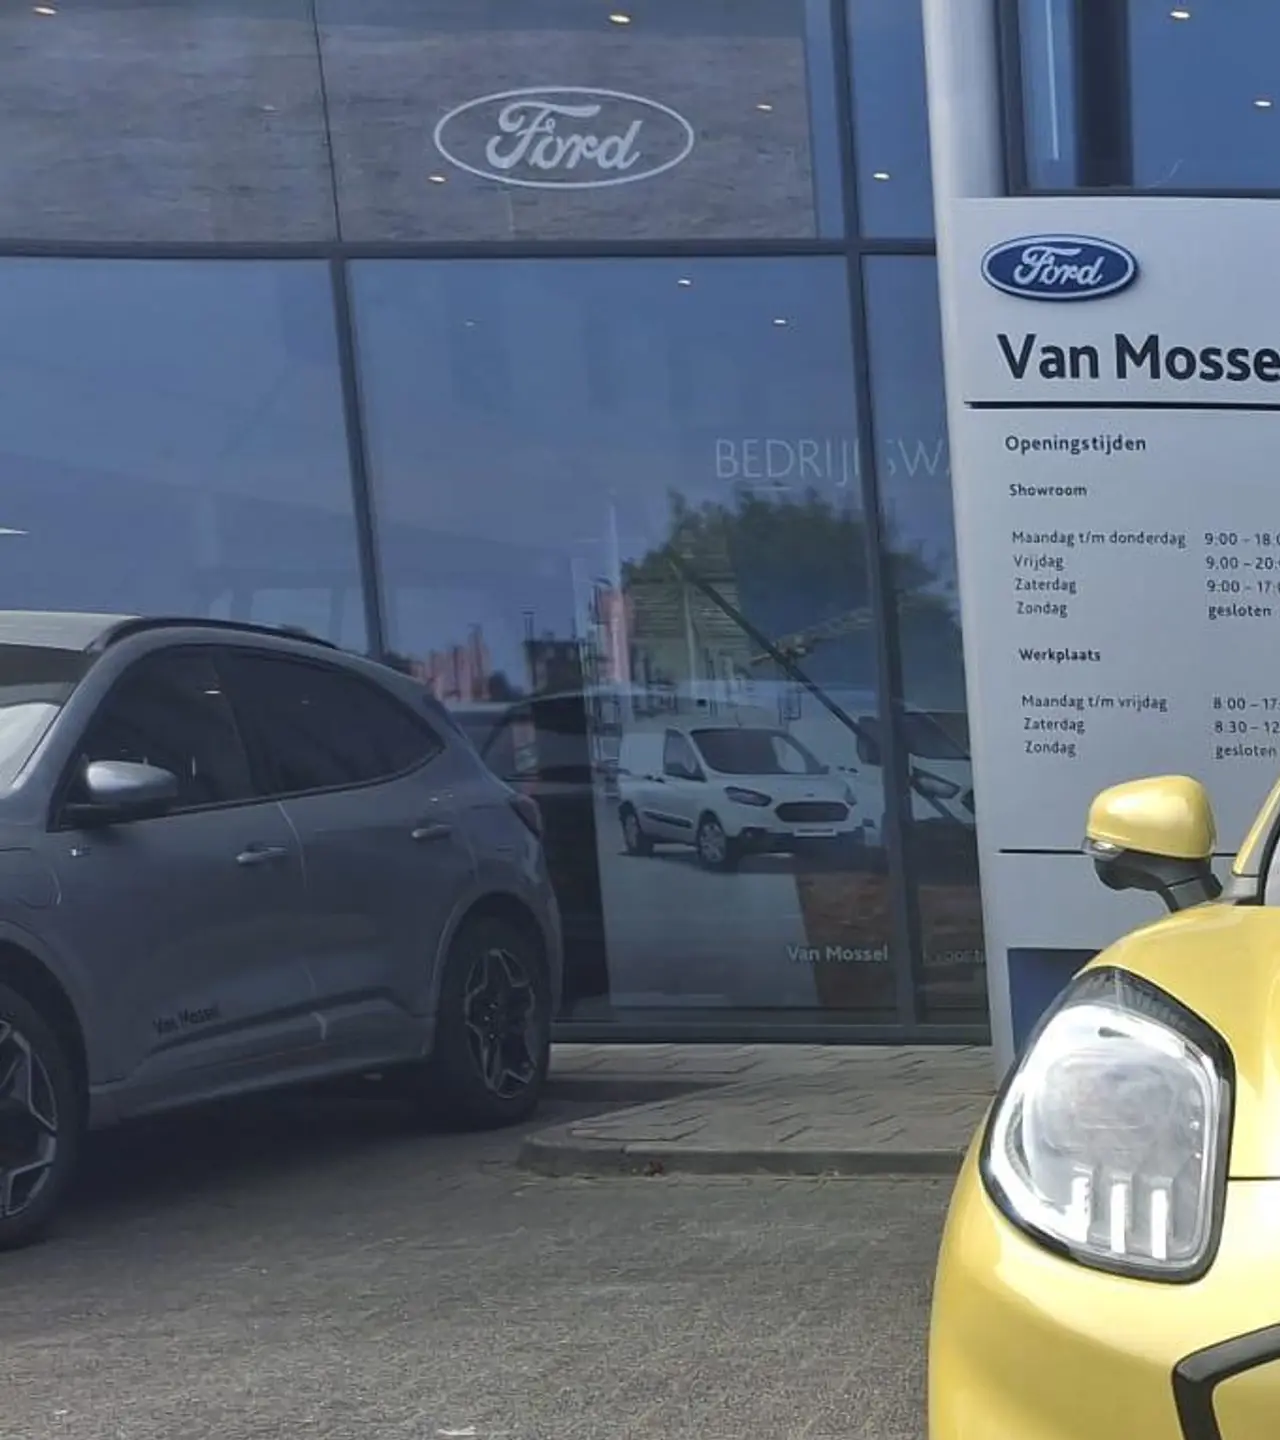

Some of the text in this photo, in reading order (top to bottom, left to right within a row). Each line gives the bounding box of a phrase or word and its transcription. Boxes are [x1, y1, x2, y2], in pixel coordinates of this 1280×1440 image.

[486, 99, 645, 171] Ford
[1012, 246, 1106, 287] Ford
[997, 333, 1099, 381] Van
[1004, 434, 1147, 455] Openingstijden
[1009, 483, 1088, 498] Showroom
[1012, 530, 1187, 549] Maandag t/m donderdag
[1014, 554, 1064, 571] Vrijdag
[1014, 578, 1077, 595] Zaterdag
[1016, 601, 1068, 618] Zondag
[1208, 602, 1272, 620] gesloten
[1018, 648, 1101, 664] Werkplaats
[1022, 694, 1168, 712] Maandag t/m vrijdag
[1023, 717, 1085, 734] Zaterdag
[1025, 740, 1076, 757] Zondag
[1215, 743, 1277, 760] gesloten
[786, 942, 889, 962] Van Mossel
